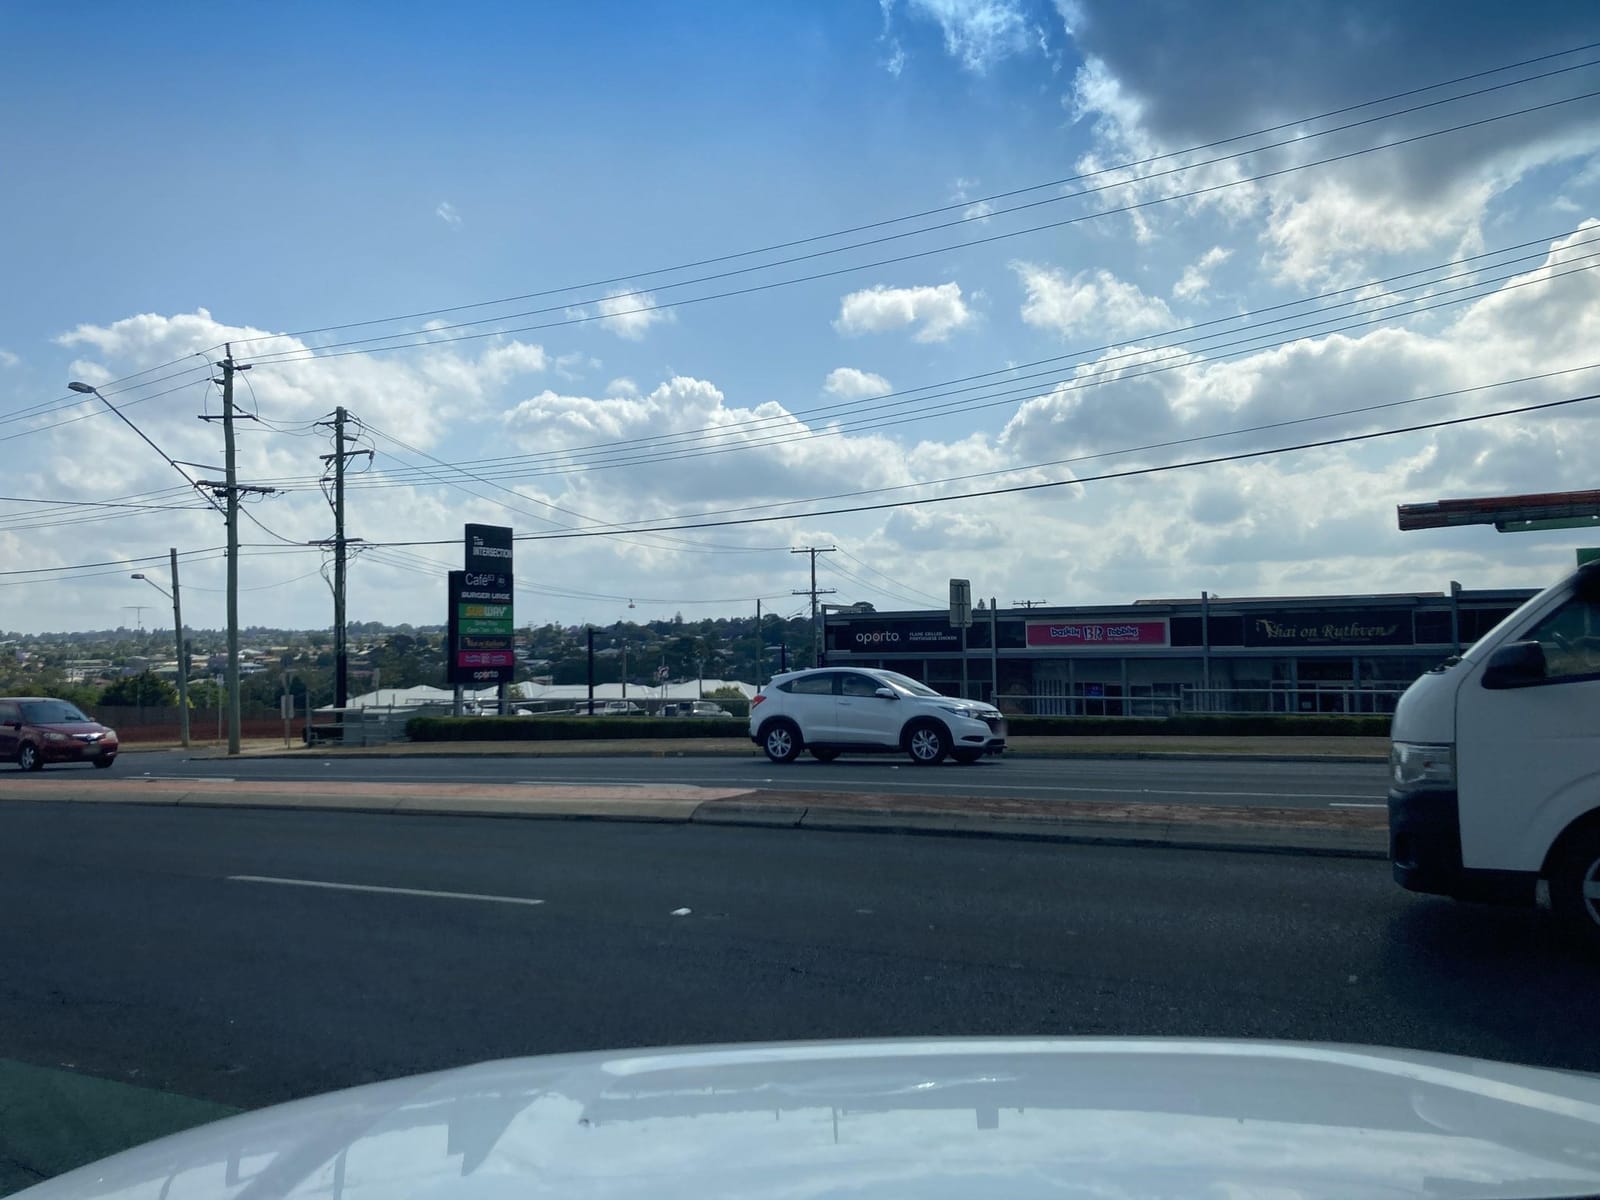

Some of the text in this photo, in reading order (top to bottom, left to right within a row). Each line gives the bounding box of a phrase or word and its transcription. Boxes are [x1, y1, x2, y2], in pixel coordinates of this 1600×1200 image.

[855, 631, 900, 645] oporto
[1300, 627, 1317, 638] on
[1321, 622, 1386, 639] Ruthven
